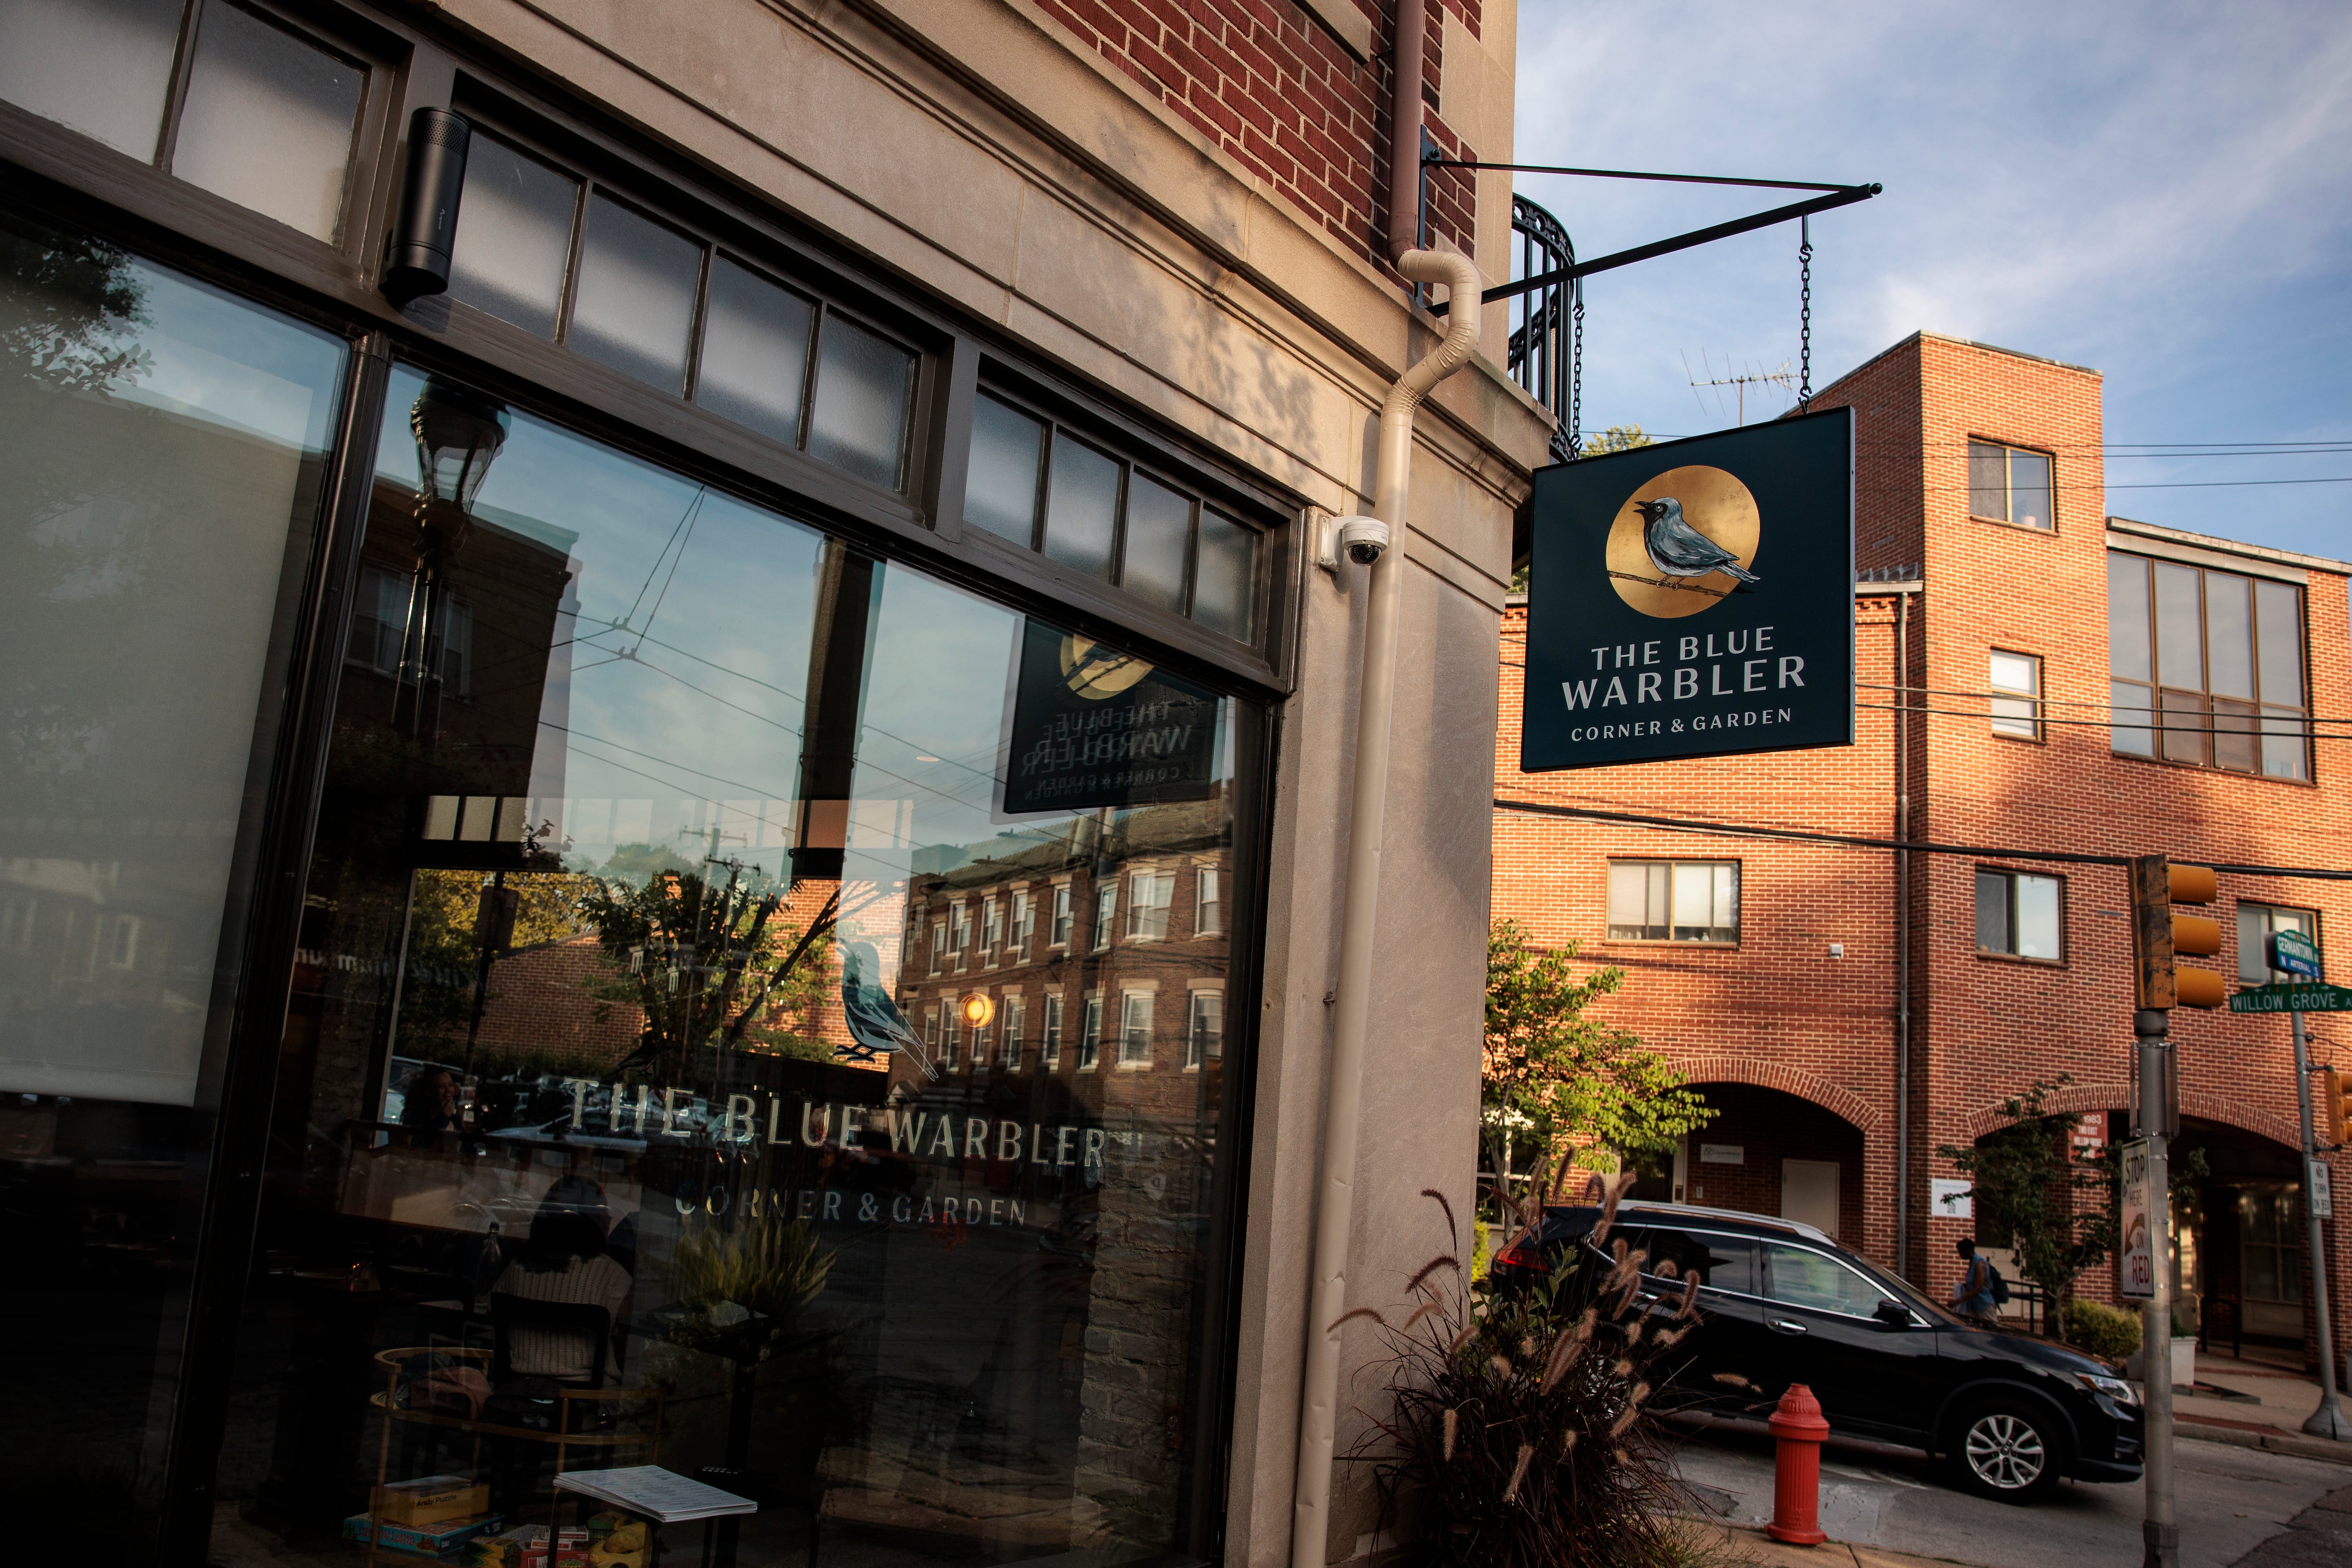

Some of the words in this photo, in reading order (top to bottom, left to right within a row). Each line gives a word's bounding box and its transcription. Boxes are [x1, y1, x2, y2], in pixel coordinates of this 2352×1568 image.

[1591, 641, 1661, 670] THE
[1680, 626, 1774, 660] BLUE
[1562, 656, 1805, 711] WARBLER
[1571, 721, 1661, 742] CORNER
[1670, 719, 1685, 732] &
[1692, 708, 1791, 731] GARDEN
[2278, 935, 2313, 962] GERMANTOWN
[2281, 955, 2286, 967] N
[2290, 959, 2311, 973] ARTERIAL
[2314, 966, 2319, 977] S
[2232, 994, 2283, 1011] WILLOW
[2291, 992, 2338, 1010] GROVE
[2345, 997, 2352, 1007] A
[564, 1077, 694, 1138] THE
[724, 1092, 868, 1152] BLUE
[887, 1108, 1104, 1168] WARBLER
[2125, 1154, 2145, 1185] STOP
[2316, 1167, 2323, 1178] NO
[2130, 1189, 2143, 1207] HERE
[2314, 1183, 2327, 1194] TURN
[675, 1183, 842, 1221] CORNER
[858, 1192, 879, 1222] &
[893, 1195, 1027, 1226] GARDEN
[2314, 1199, 2320, 1209] ON
[2137, 1231, 2145, 1250] ON
[2133, 1256, 2150, 1283] RED
[416, 1497, 434, 1507] Andy
[436, 1494, 457, 1503] Puzzle
[358, 1526, 389, 1541] CADY
[390, 1531, 415, 1545] LAND
